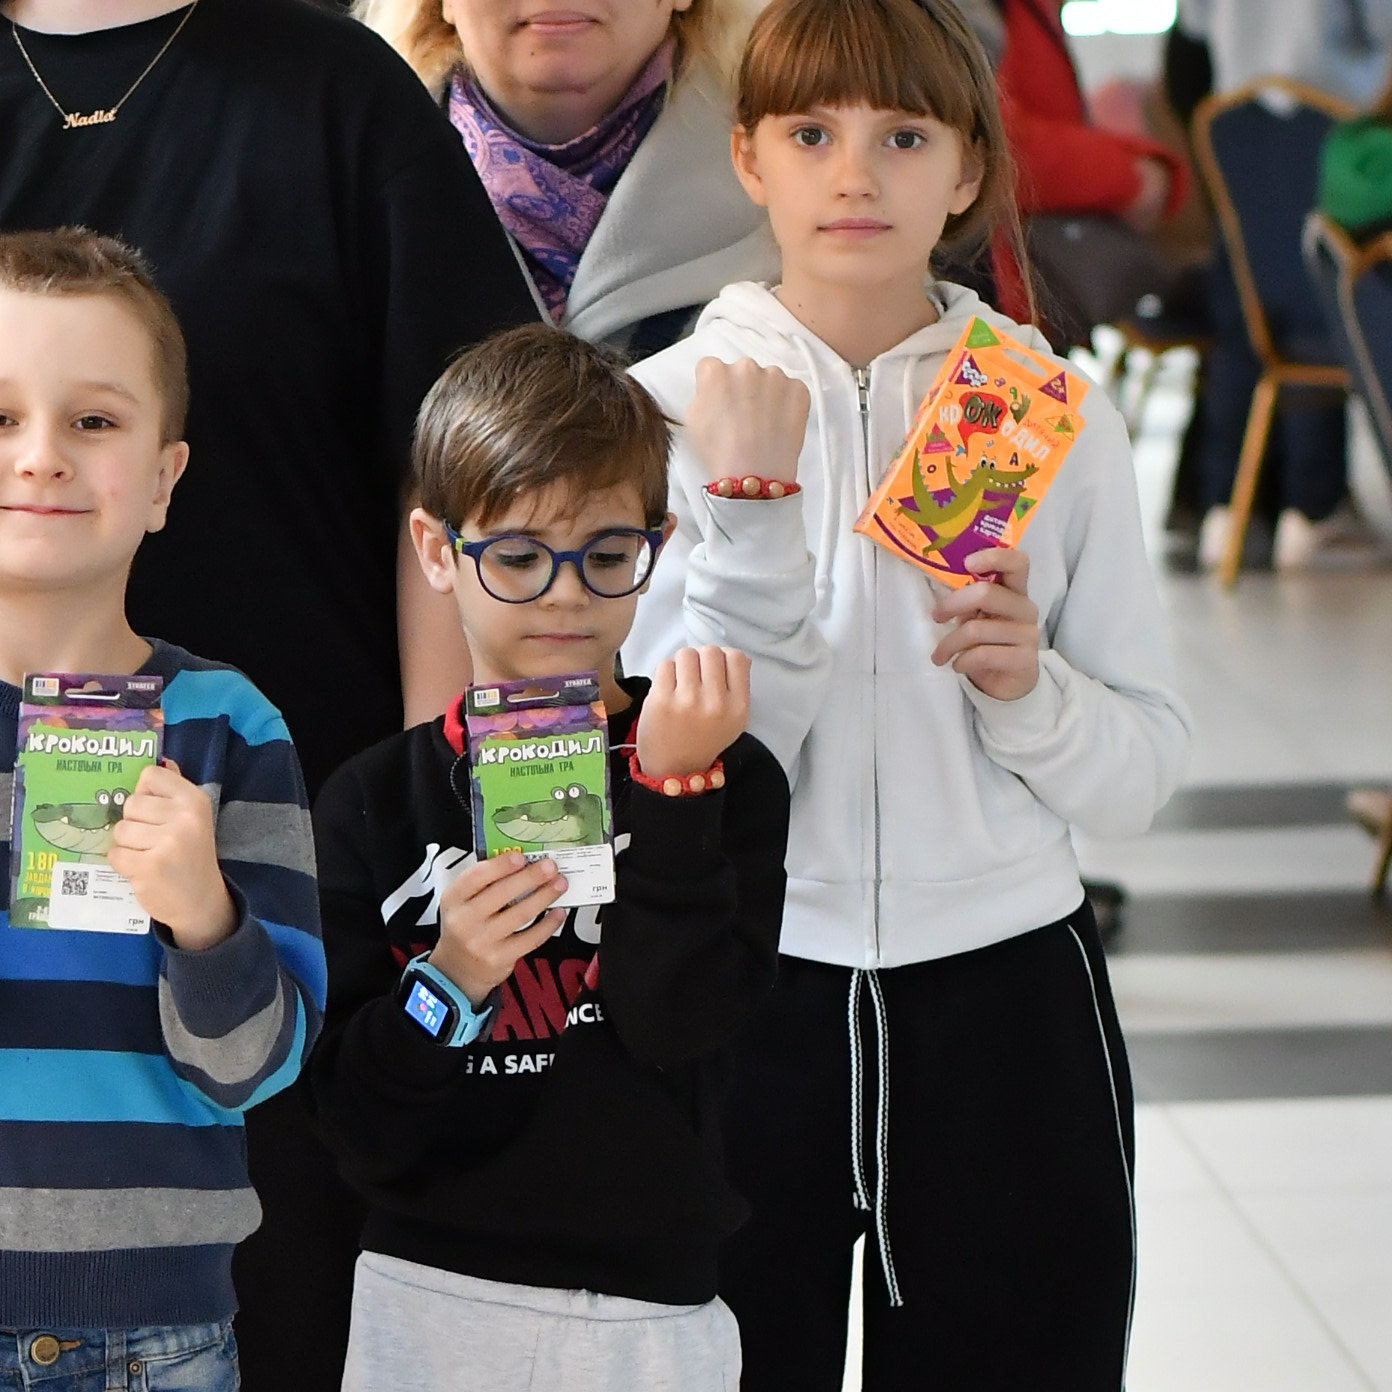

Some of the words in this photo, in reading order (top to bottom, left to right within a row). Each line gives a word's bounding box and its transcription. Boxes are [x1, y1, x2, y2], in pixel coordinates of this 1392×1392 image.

[29, 733, 154, 757] КРОКОДИЛ
[481, 736, 602, 764] КРОКОДИЛ
[56, 759, 102, 773] НАСТІЛЬНА
[107, 762, 123, 773] ГРА
[510, 762, 554, 777] НАСТІЛЬНА
[559, 761, 574, 773] ГРА
[592, 885, 608, 893] грн
[129, 918, 144, 926] грн
[480, 1056, 498, 1074] A
